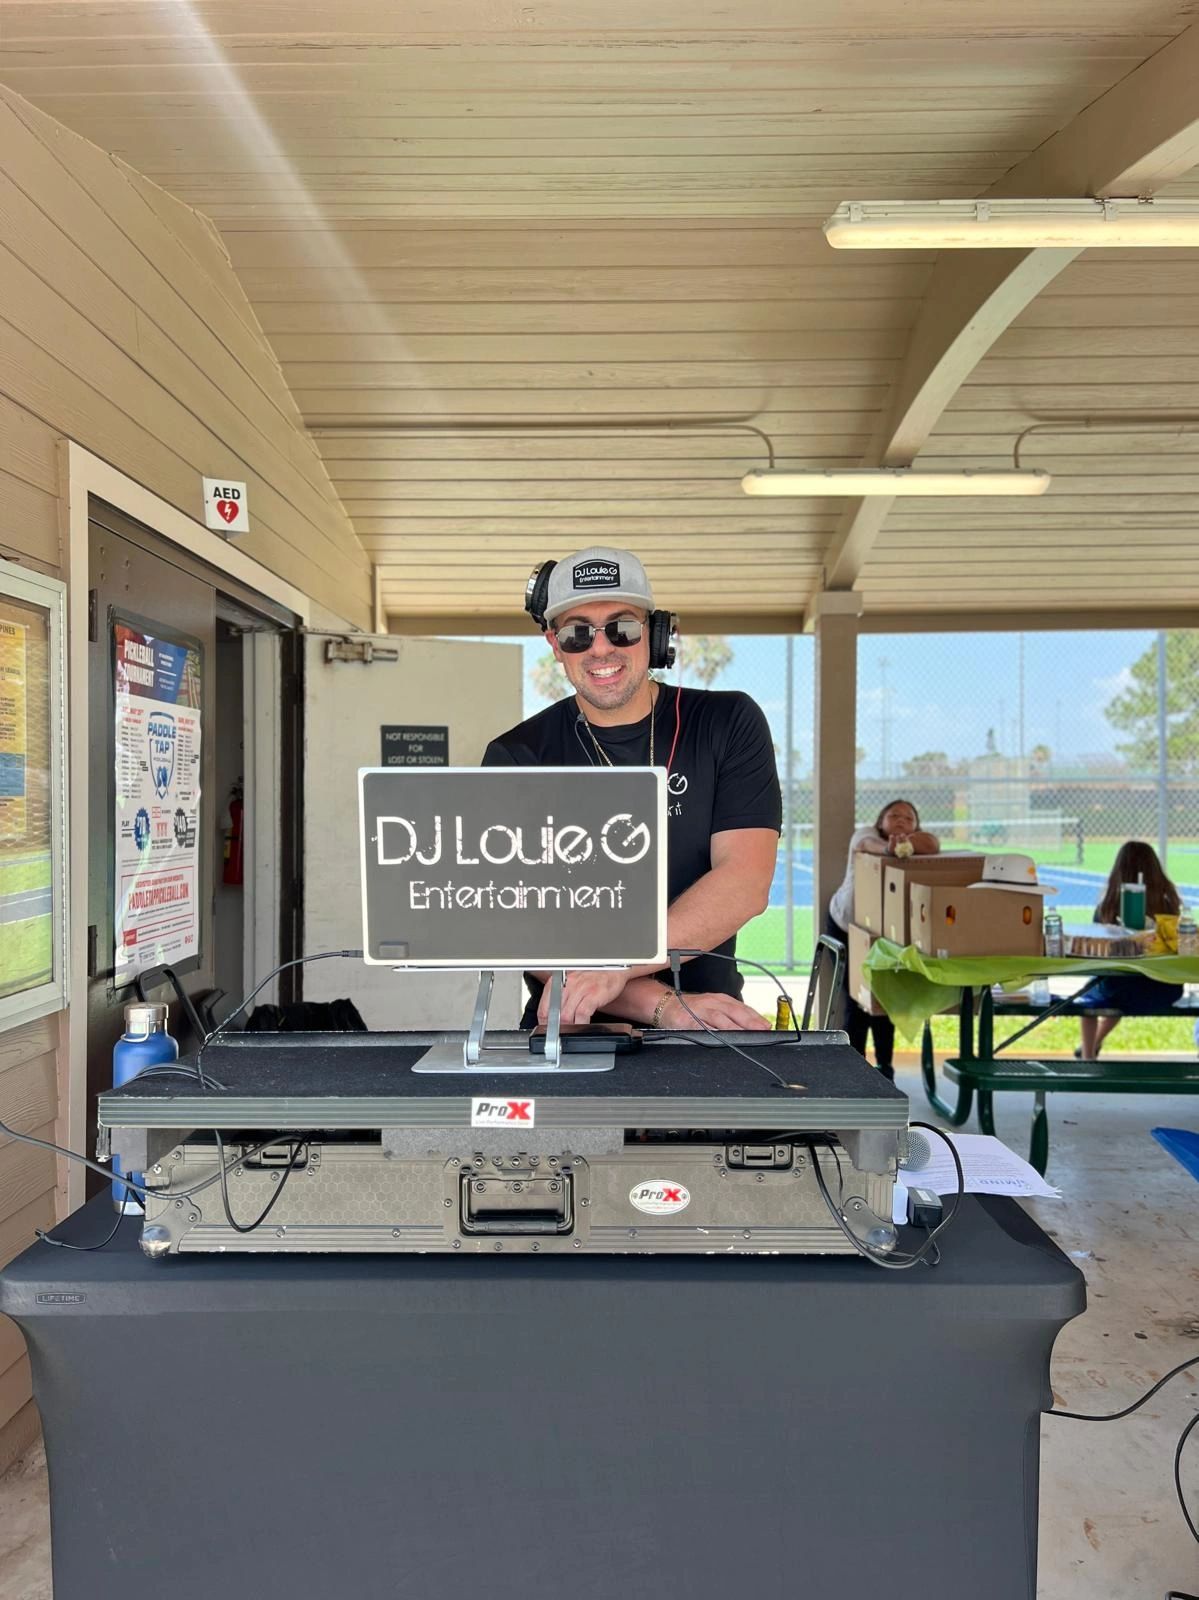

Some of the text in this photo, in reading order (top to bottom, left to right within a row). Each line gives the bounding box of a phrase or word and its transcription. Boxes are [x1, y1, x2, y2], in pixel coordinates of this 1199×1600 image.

[213, 486, 241, 500] AED
[575, 566, 617, 578] DJ Louie G
[124, 639, 154, 667] PICKLEBALL
[124, 662, 154, 688] TOURNAMENT
[148, 722, 176, 739] PADDLE
[385, 733, 445, 742] NOT RESPONSIBLE
[155, 740, 170, 754] TAP
[408, 744, 423, 752] FOR
[388, 756, 444, 764] LOST OR STOLEN
[376, 813, 650, 865] DJ Louie G
[409, 880, 626, 909] Entertainment
[476, 1101, 531, 1120] ProX
[639, 1188, 682, 1202] ProX
[42, 1294, 80, 1302] LIFETIME
